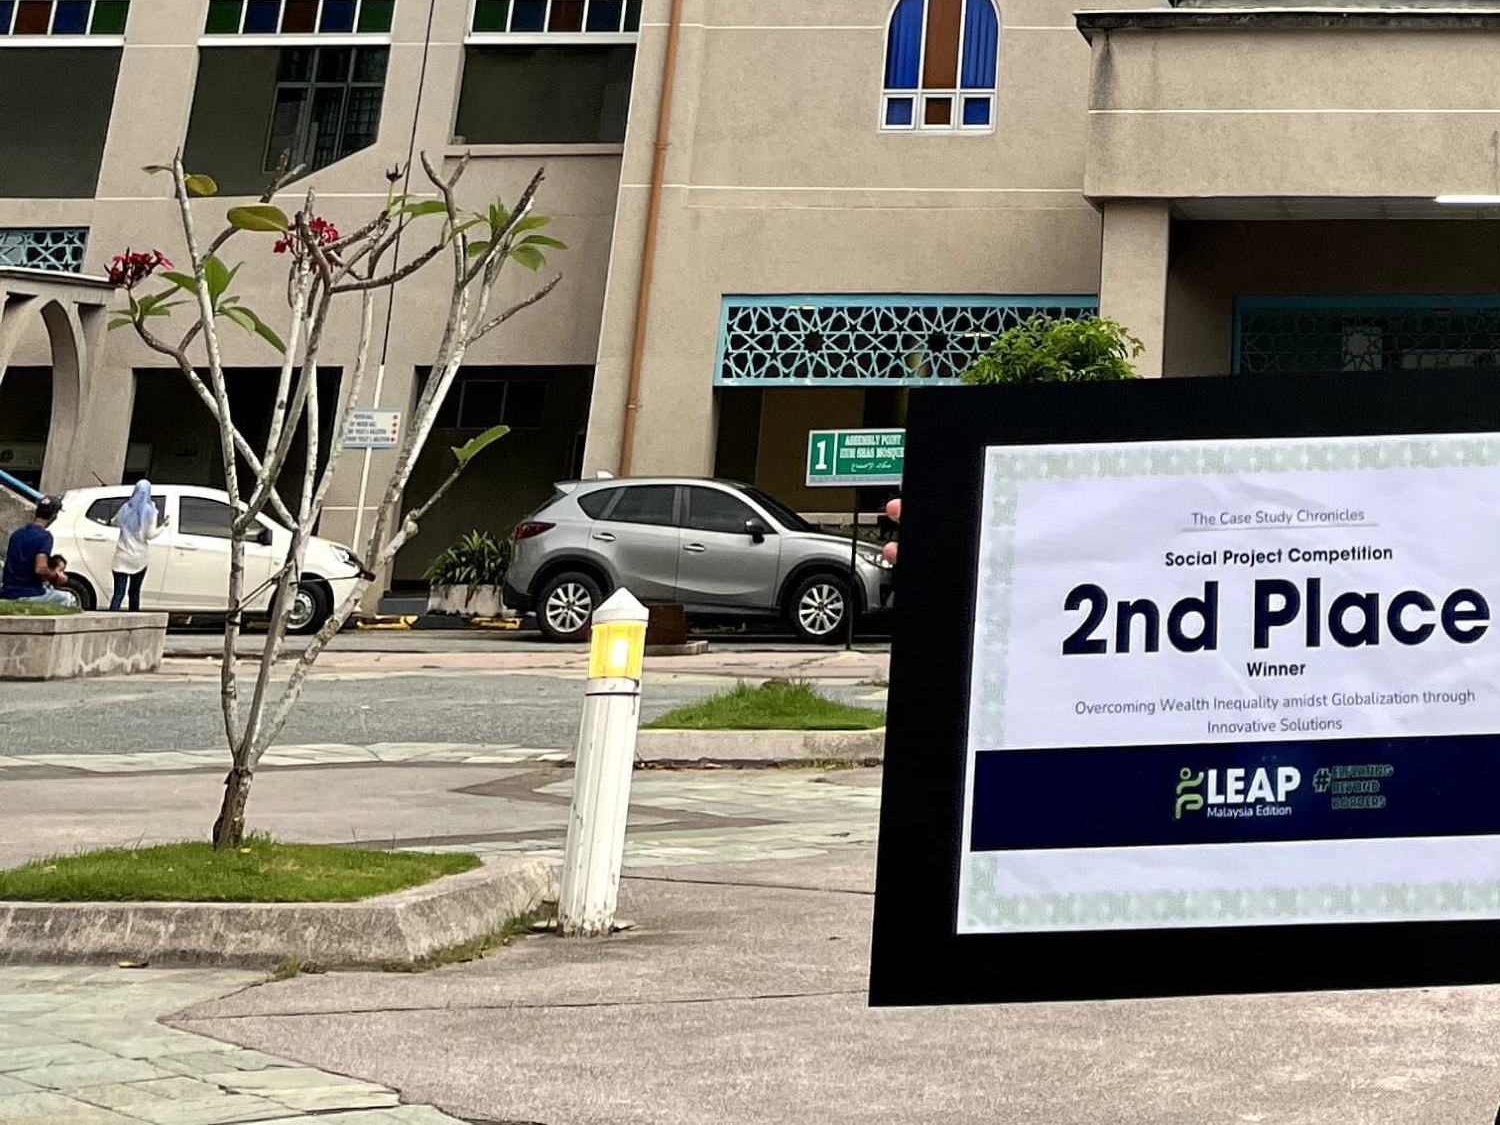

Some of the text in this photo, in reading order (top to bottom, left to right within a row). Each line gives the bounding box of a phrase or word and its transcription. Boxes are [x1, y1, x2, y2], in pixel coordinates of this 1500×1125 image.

[881, 434, 902, 446] POINT
[815, 440, 828, 470] 1
[1191, 509, 1365, 526] The Case Study Chronicles
[1165, 545, 1393, 568] Social Project Competition
[1062, 577, 1491, 655] 2nd Place
[1246, 661, 1306, 677] Winner
[1075, 689, 1476, 715] Overcoming Wealth Inequality amidst Globalization through
[1207, 716, 1343, 734] Innovative Solutions
[1207, 766, 1301, 804] LEAP
[1207, 805, 1292, 819] Malaysia Edition
